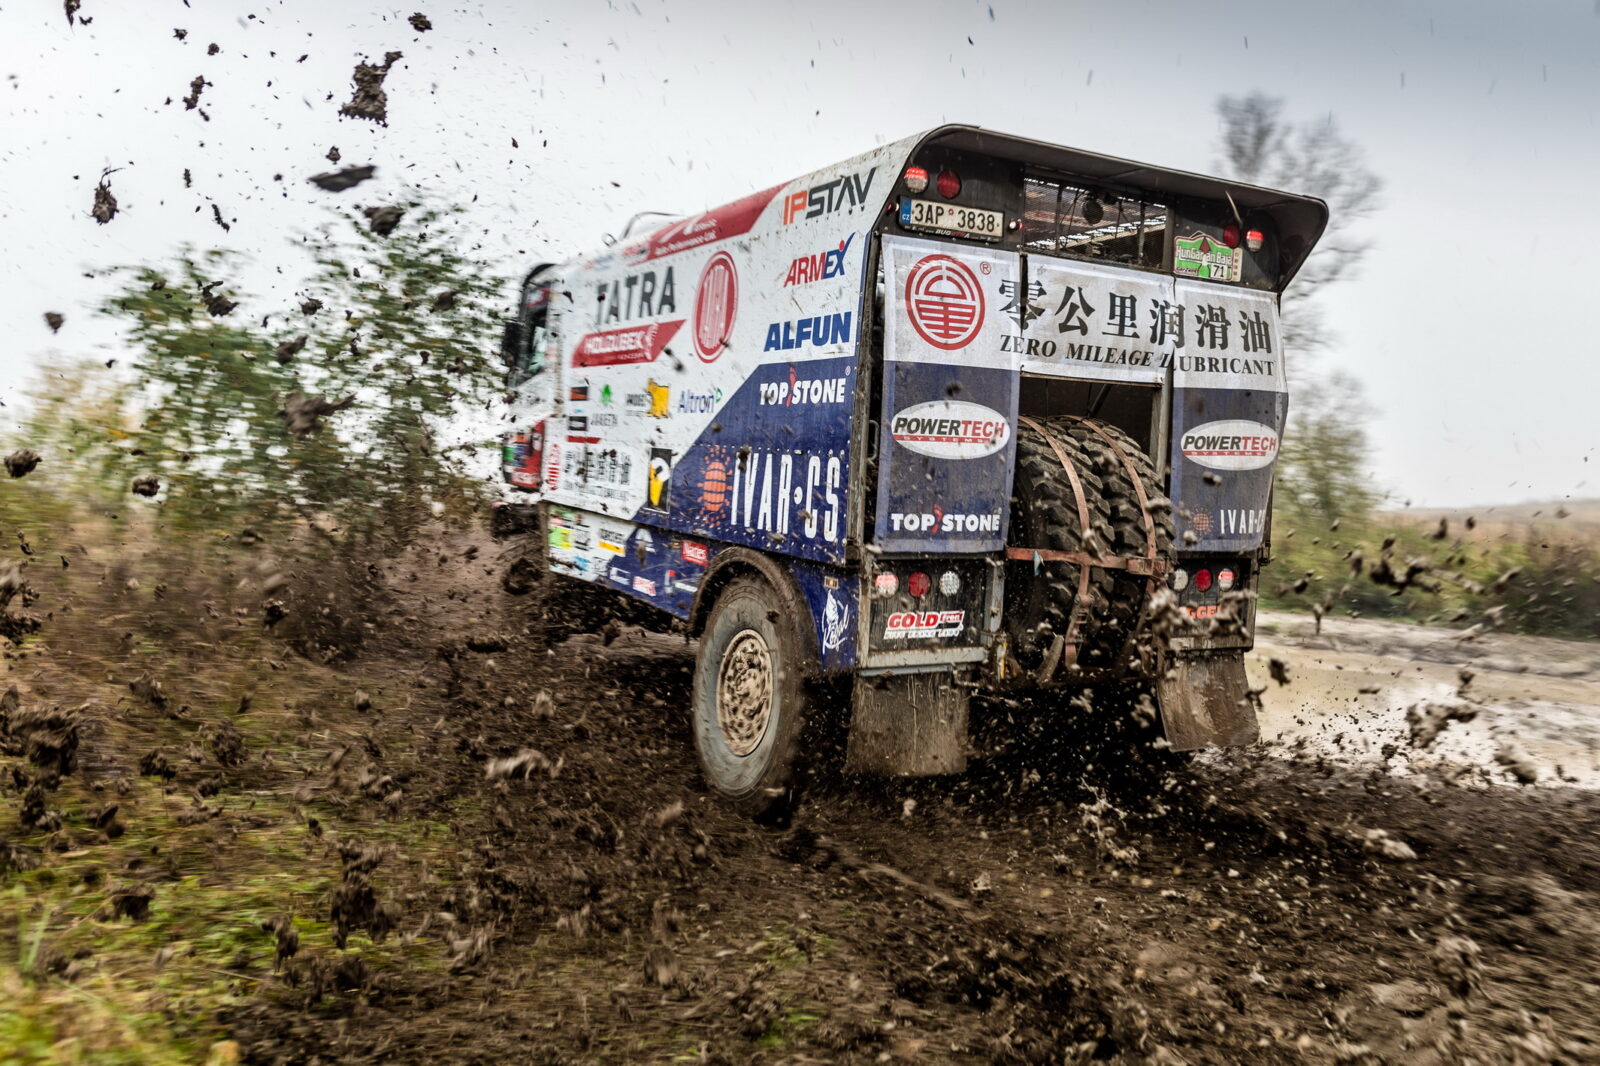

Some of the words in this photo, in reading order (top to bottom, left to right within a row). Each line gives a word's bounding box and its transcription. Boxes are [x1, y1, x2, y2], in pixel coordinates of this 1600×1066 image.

[783, 167, 877, 226] IPSTAV
[914, 203, 944, 225] 3AP
[957, 209, 995, 233] 3838
[783, 232, 856, 288] ARMEX
[1213, 264, 1225, 278] 71
[596, 266, 676, 325] TATRA
[763, 311, 852, 352] ALFUN
[1000, 334, 1057, 358] ZERO
[1065, 342, 1154, 368] MILEAGE
[893, 417, 1006, 438] POWERTECH
[1183, 435, 1277, 451] POWERTECH
